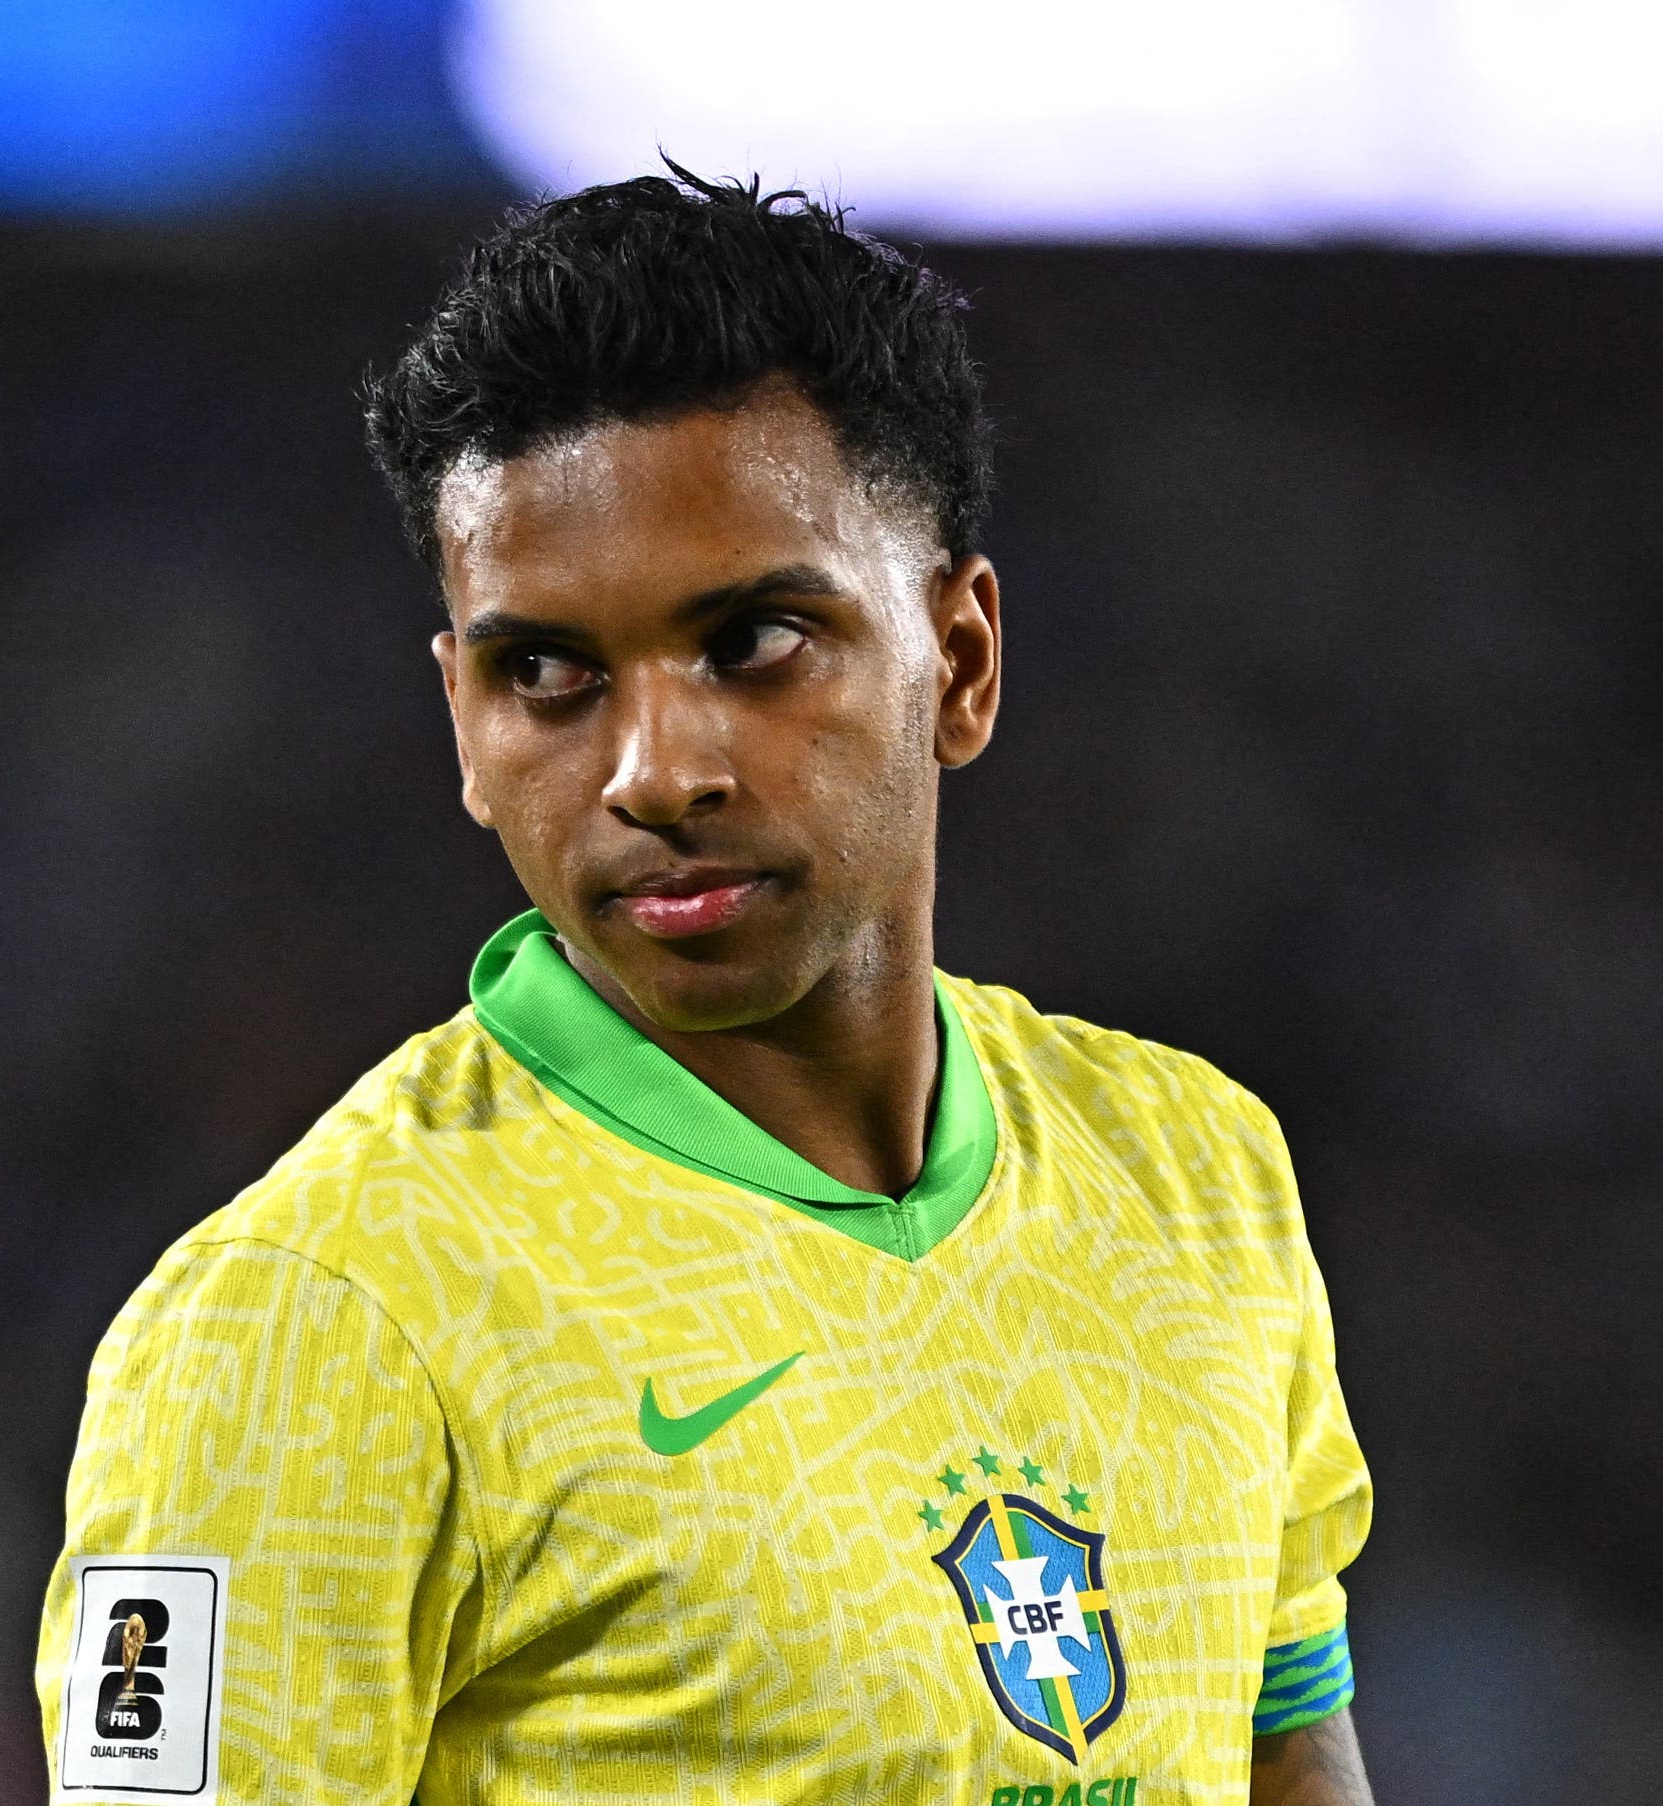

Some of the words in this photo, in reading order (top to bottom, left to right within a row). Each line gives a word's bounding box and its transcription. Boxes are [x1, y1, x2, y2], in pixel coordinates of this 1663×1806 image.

[1007, 1600, 1065, 1636] CBF
[109, 1711, 141, 1728] FIFA
[90, 1745, 159, 1761] QUALIFIERS
